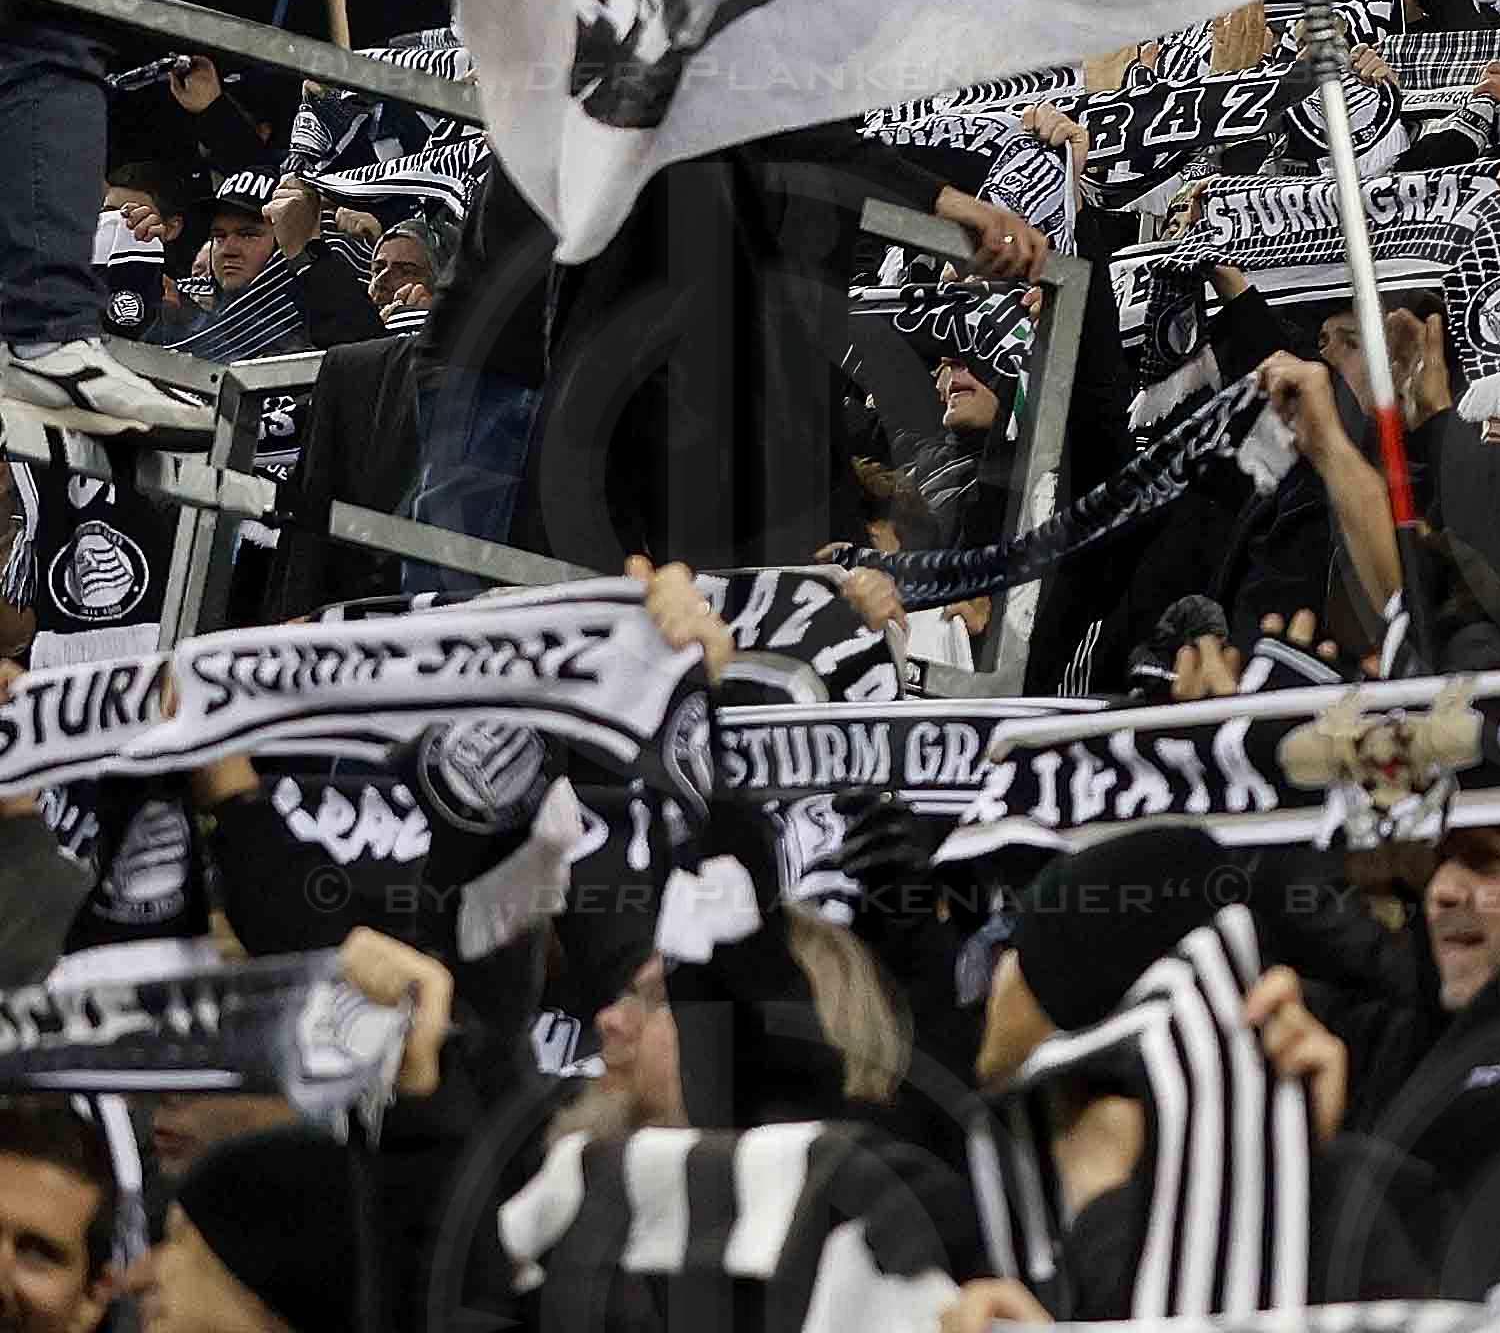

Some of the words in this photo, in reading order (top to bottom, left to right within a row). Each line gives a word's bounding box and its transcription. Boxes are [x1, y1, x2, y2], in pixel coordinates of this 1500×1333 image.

[1082, 76, 1284, 158] RAZ
[1208, 182, 1340, 247] STURM
[1364, 172, 1500, 234] GRAZ
[717, 721, 892, 791] STURM
